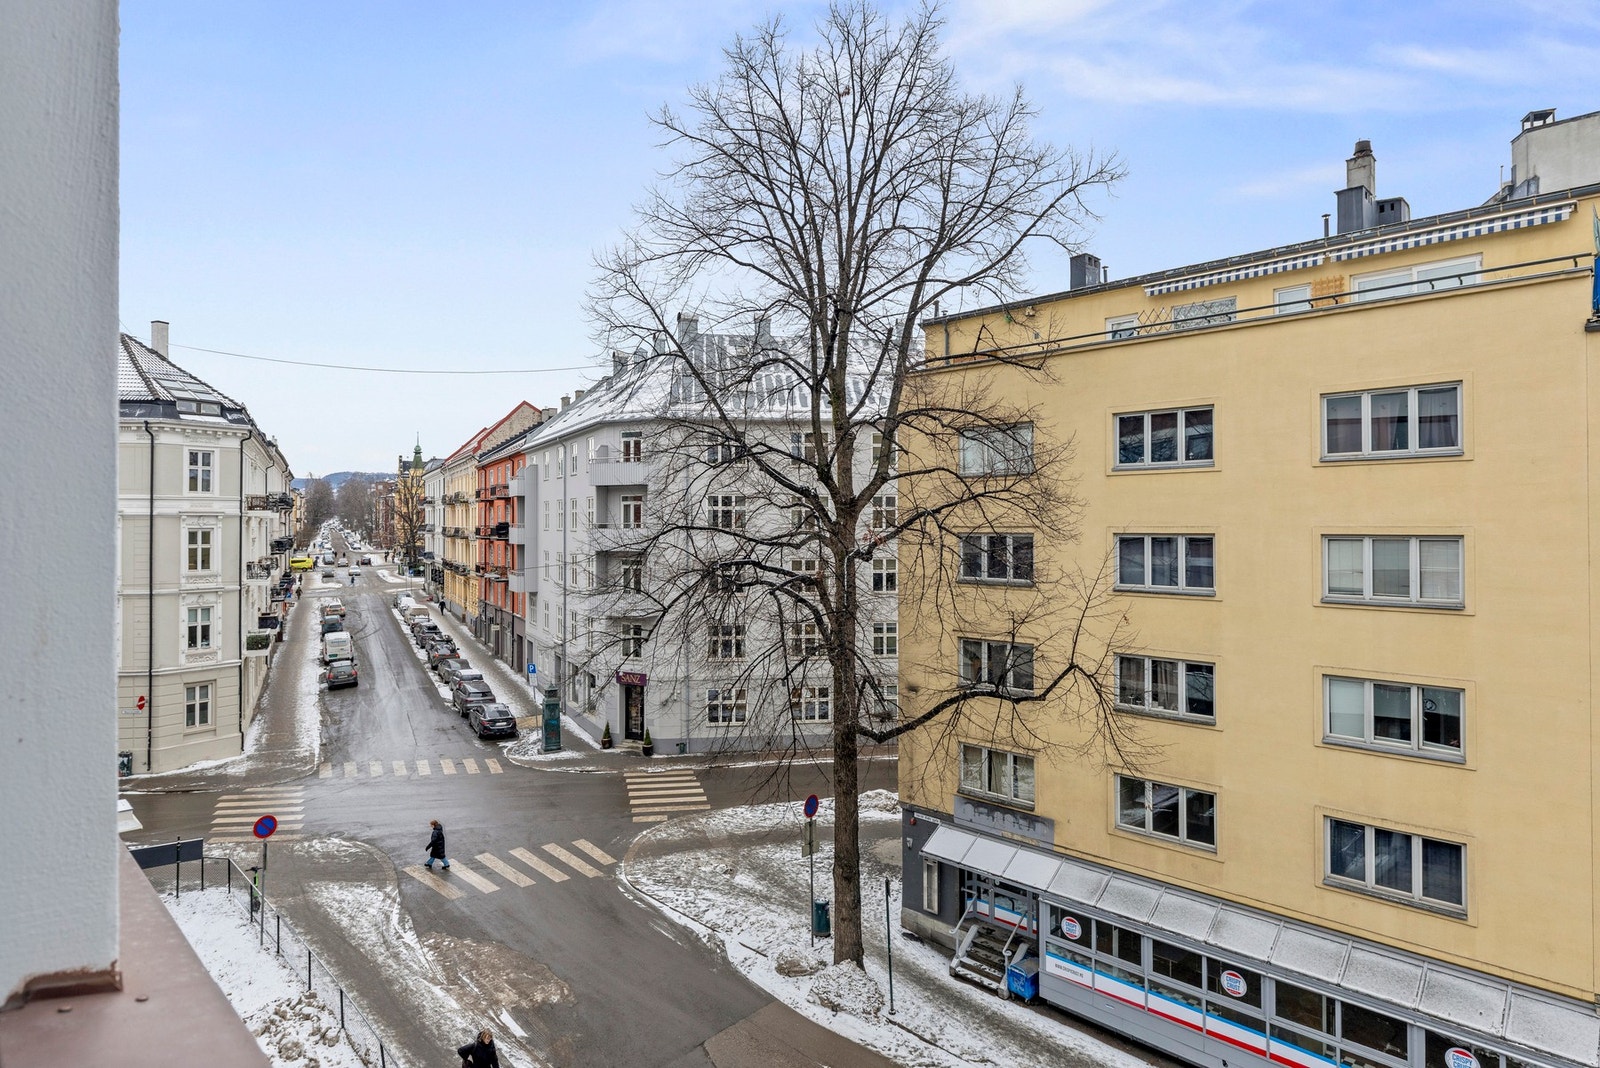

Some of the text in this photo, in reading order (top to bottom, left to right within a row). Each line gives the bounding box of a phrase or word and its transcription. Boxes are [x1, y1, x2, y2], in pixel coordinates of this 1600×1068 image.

[621, 674, 641, 684] SANZ
[1065, 920, 1078, 930] CRISPY
[1226, 975, 1241, 986] CRISPY
[1226, 981, 1240, 991] CRUST
[1452, 1053, 1473, 1067] CRISPY
